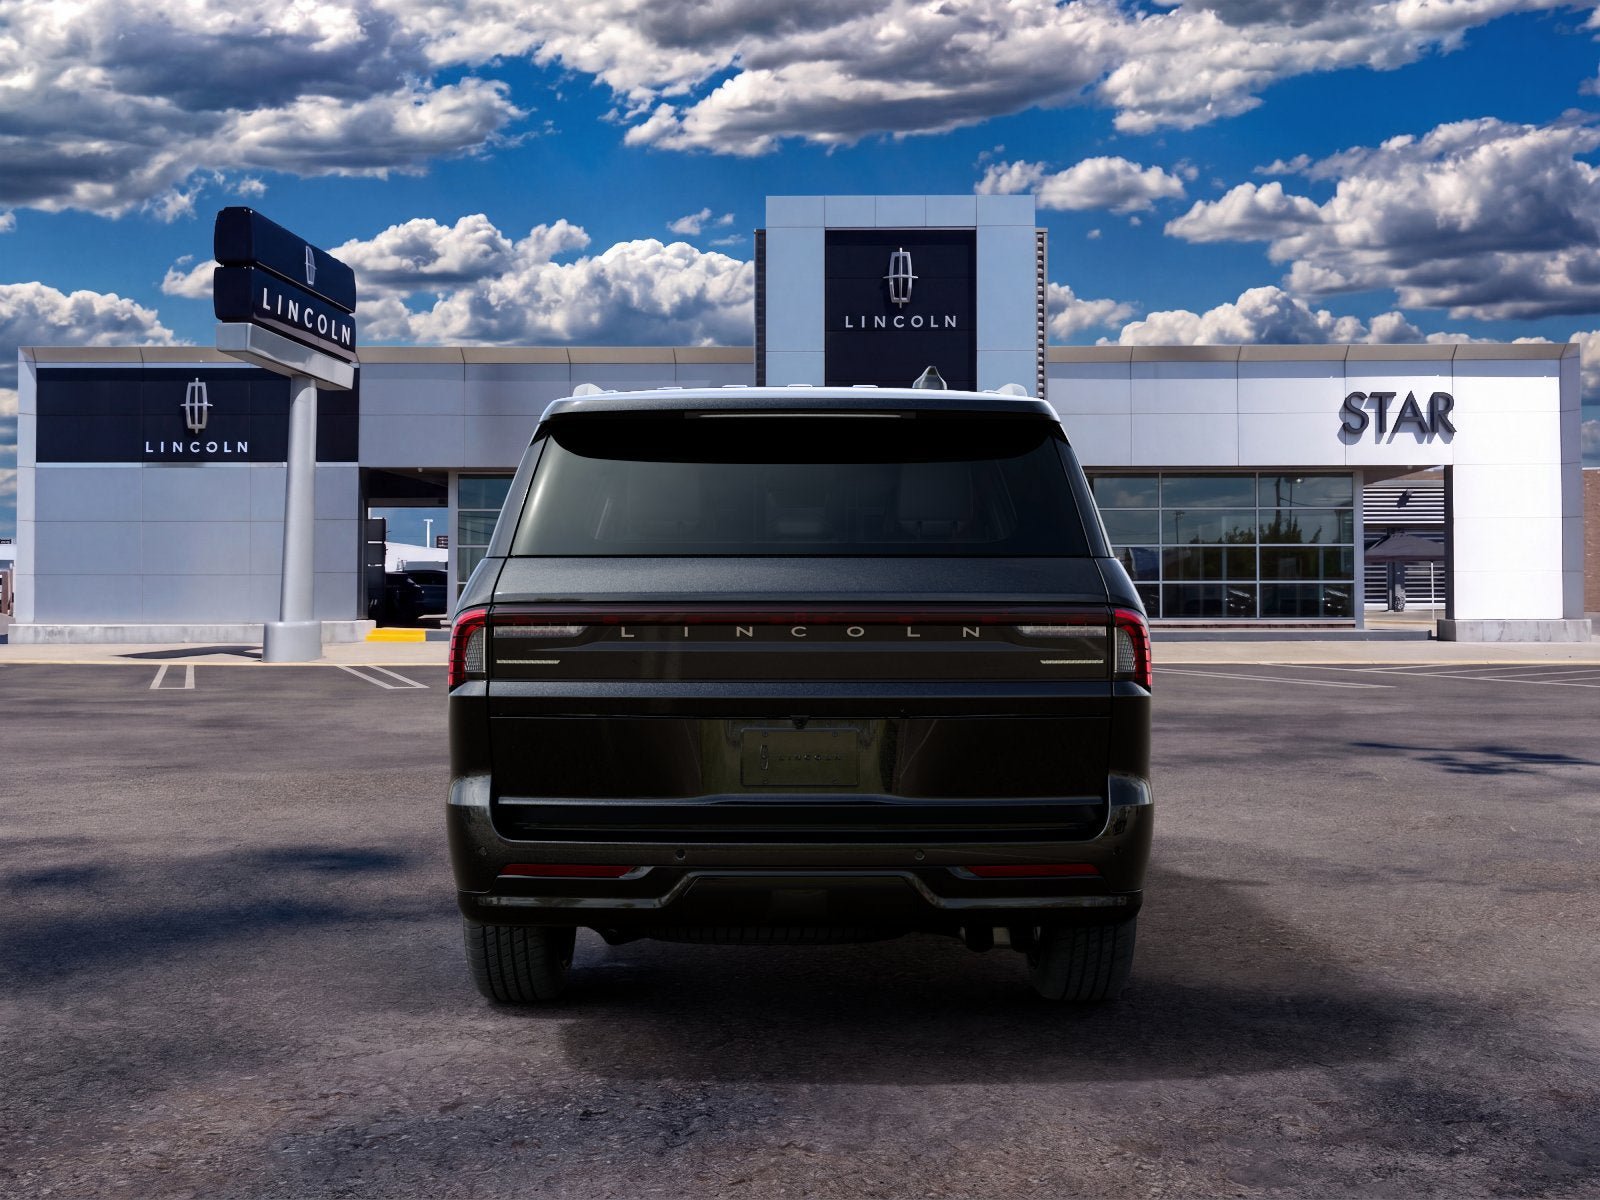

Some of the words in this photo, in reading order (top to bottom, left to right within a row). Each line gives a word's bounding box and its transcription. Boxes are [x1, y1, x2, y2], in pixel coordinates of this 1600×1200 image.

[262, 287, 351, 346] LINCOLN
[845, 315, 957, 329] LINCOLN
[1342, 390, 1458, 435] STAR
[144, 441, 249, 453] LINCOLN
[620, 626, 981, 638] LINCOLN
